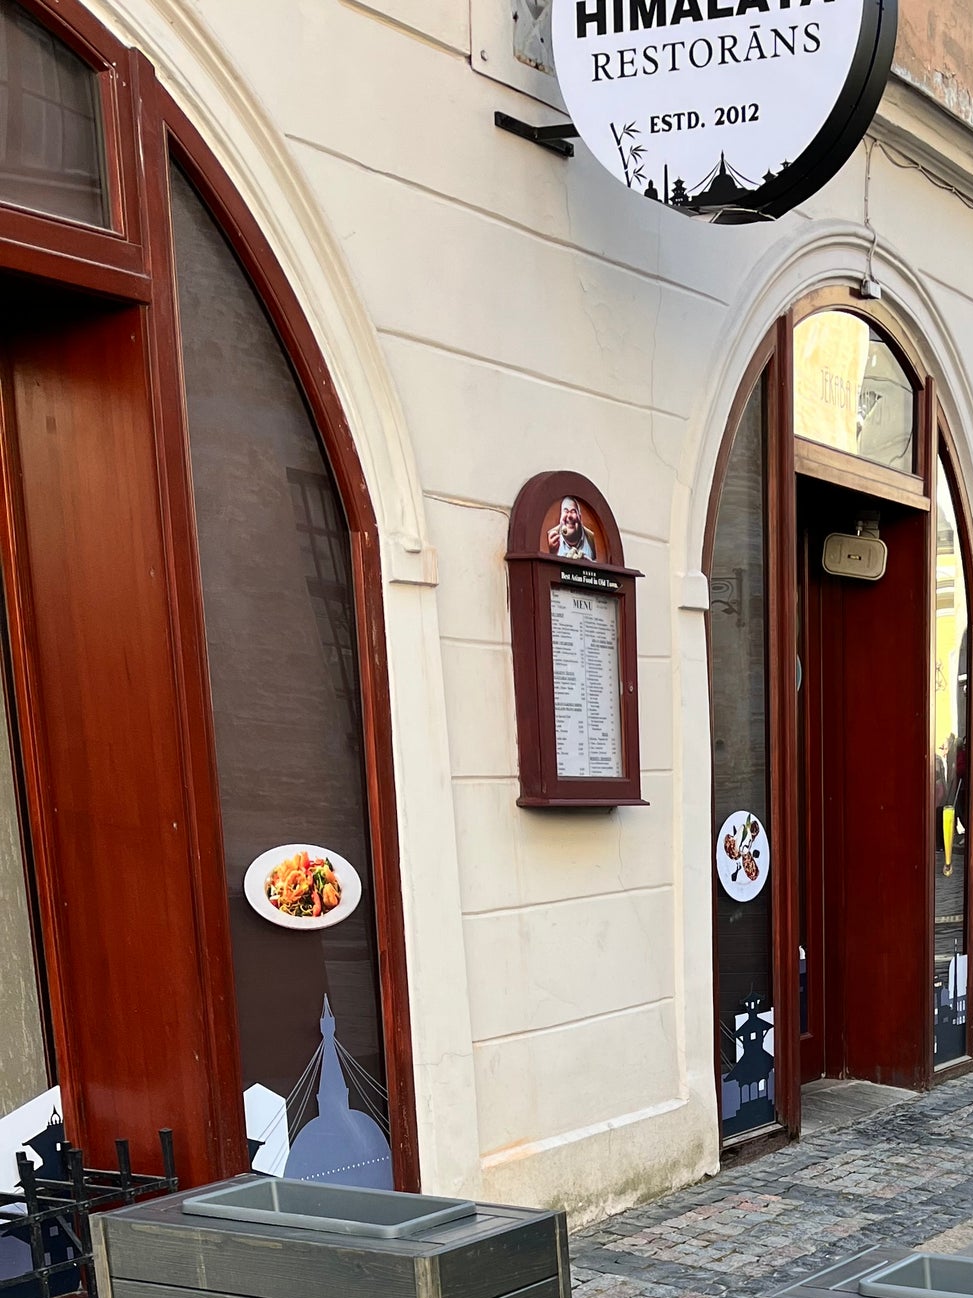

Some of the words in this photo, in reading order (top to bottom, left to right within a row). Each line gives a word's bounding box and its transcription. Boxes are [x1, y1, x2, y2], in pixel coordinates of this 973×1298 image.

[576, 0, 836, 38] HIMAL
[591, 22, 821, 82] RESTORĀNS
[650, 111, 705, 134] ESTD.
[714, 103, 760, 126] 2012
[572, 599, 593, 611] MENU
